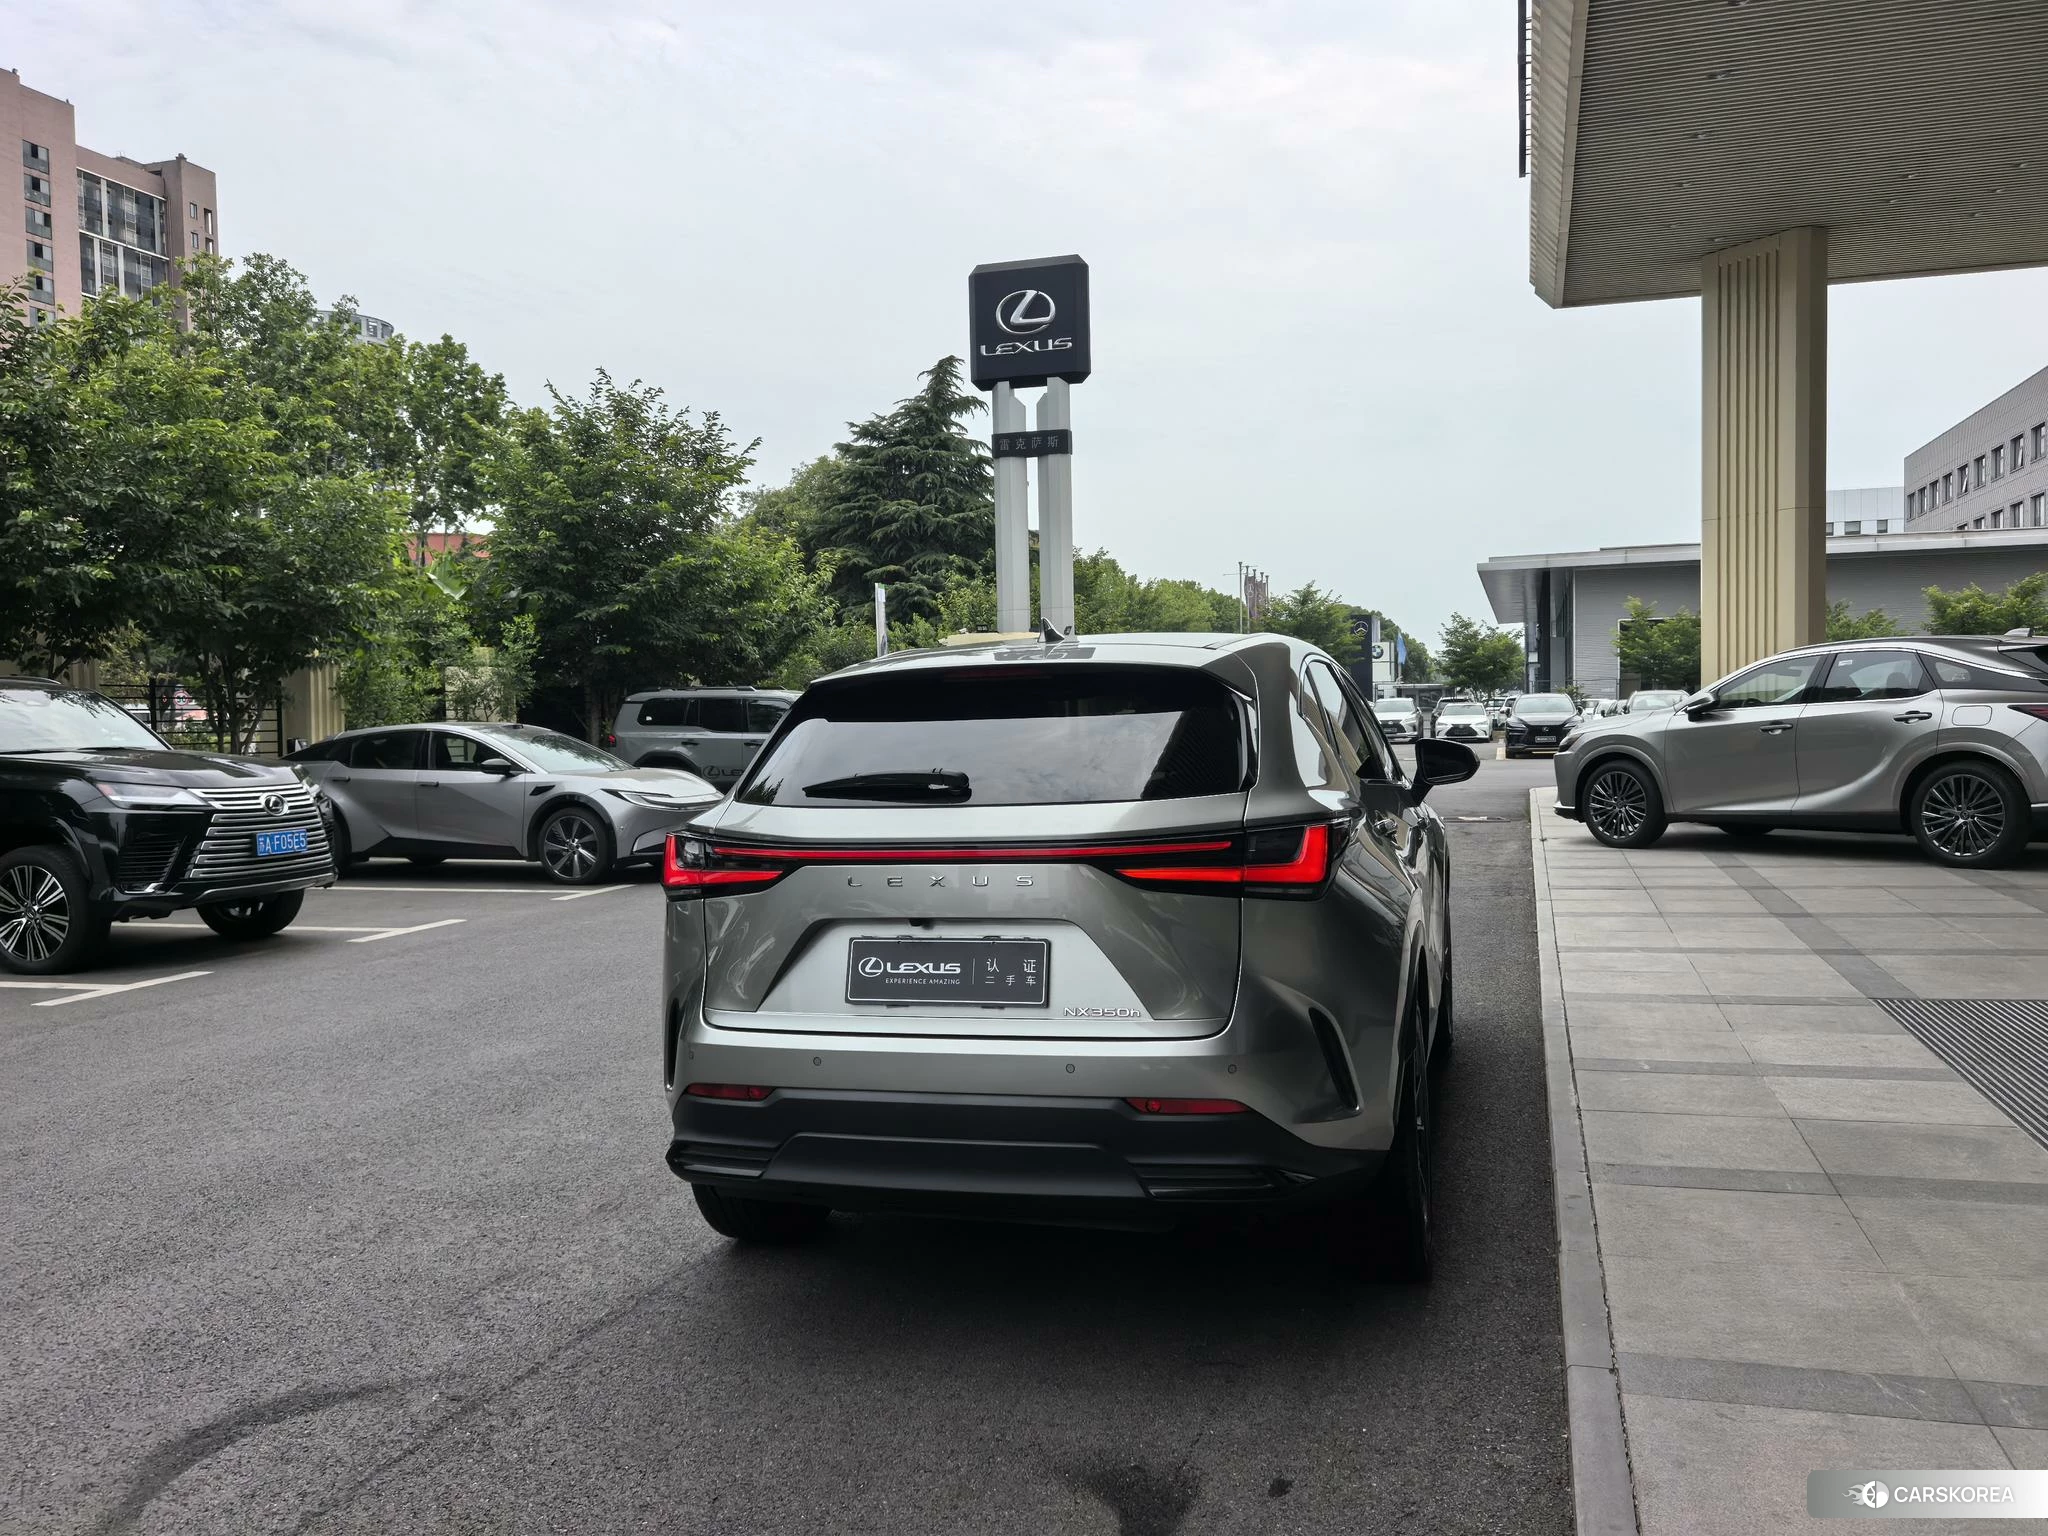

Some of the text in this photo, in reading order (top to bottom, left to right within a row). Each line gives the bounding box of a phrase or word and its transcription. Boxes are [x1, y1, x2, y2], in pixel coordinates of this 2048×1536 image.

[980, 337, 1073, 355] LEXUS
[999, 435, 1059, 451] 雷克萨斯
[847, 875, 1034, 888] LEXUS
[885, 962, 961, 974] LEXUS
[986, 958, 1037, 973] 认证
[885, 977, 927, 985] EXPERIENCE
[985, 975, 1037, 986] 二手车
[1063, 1006, 1141, 1018] NX350h
